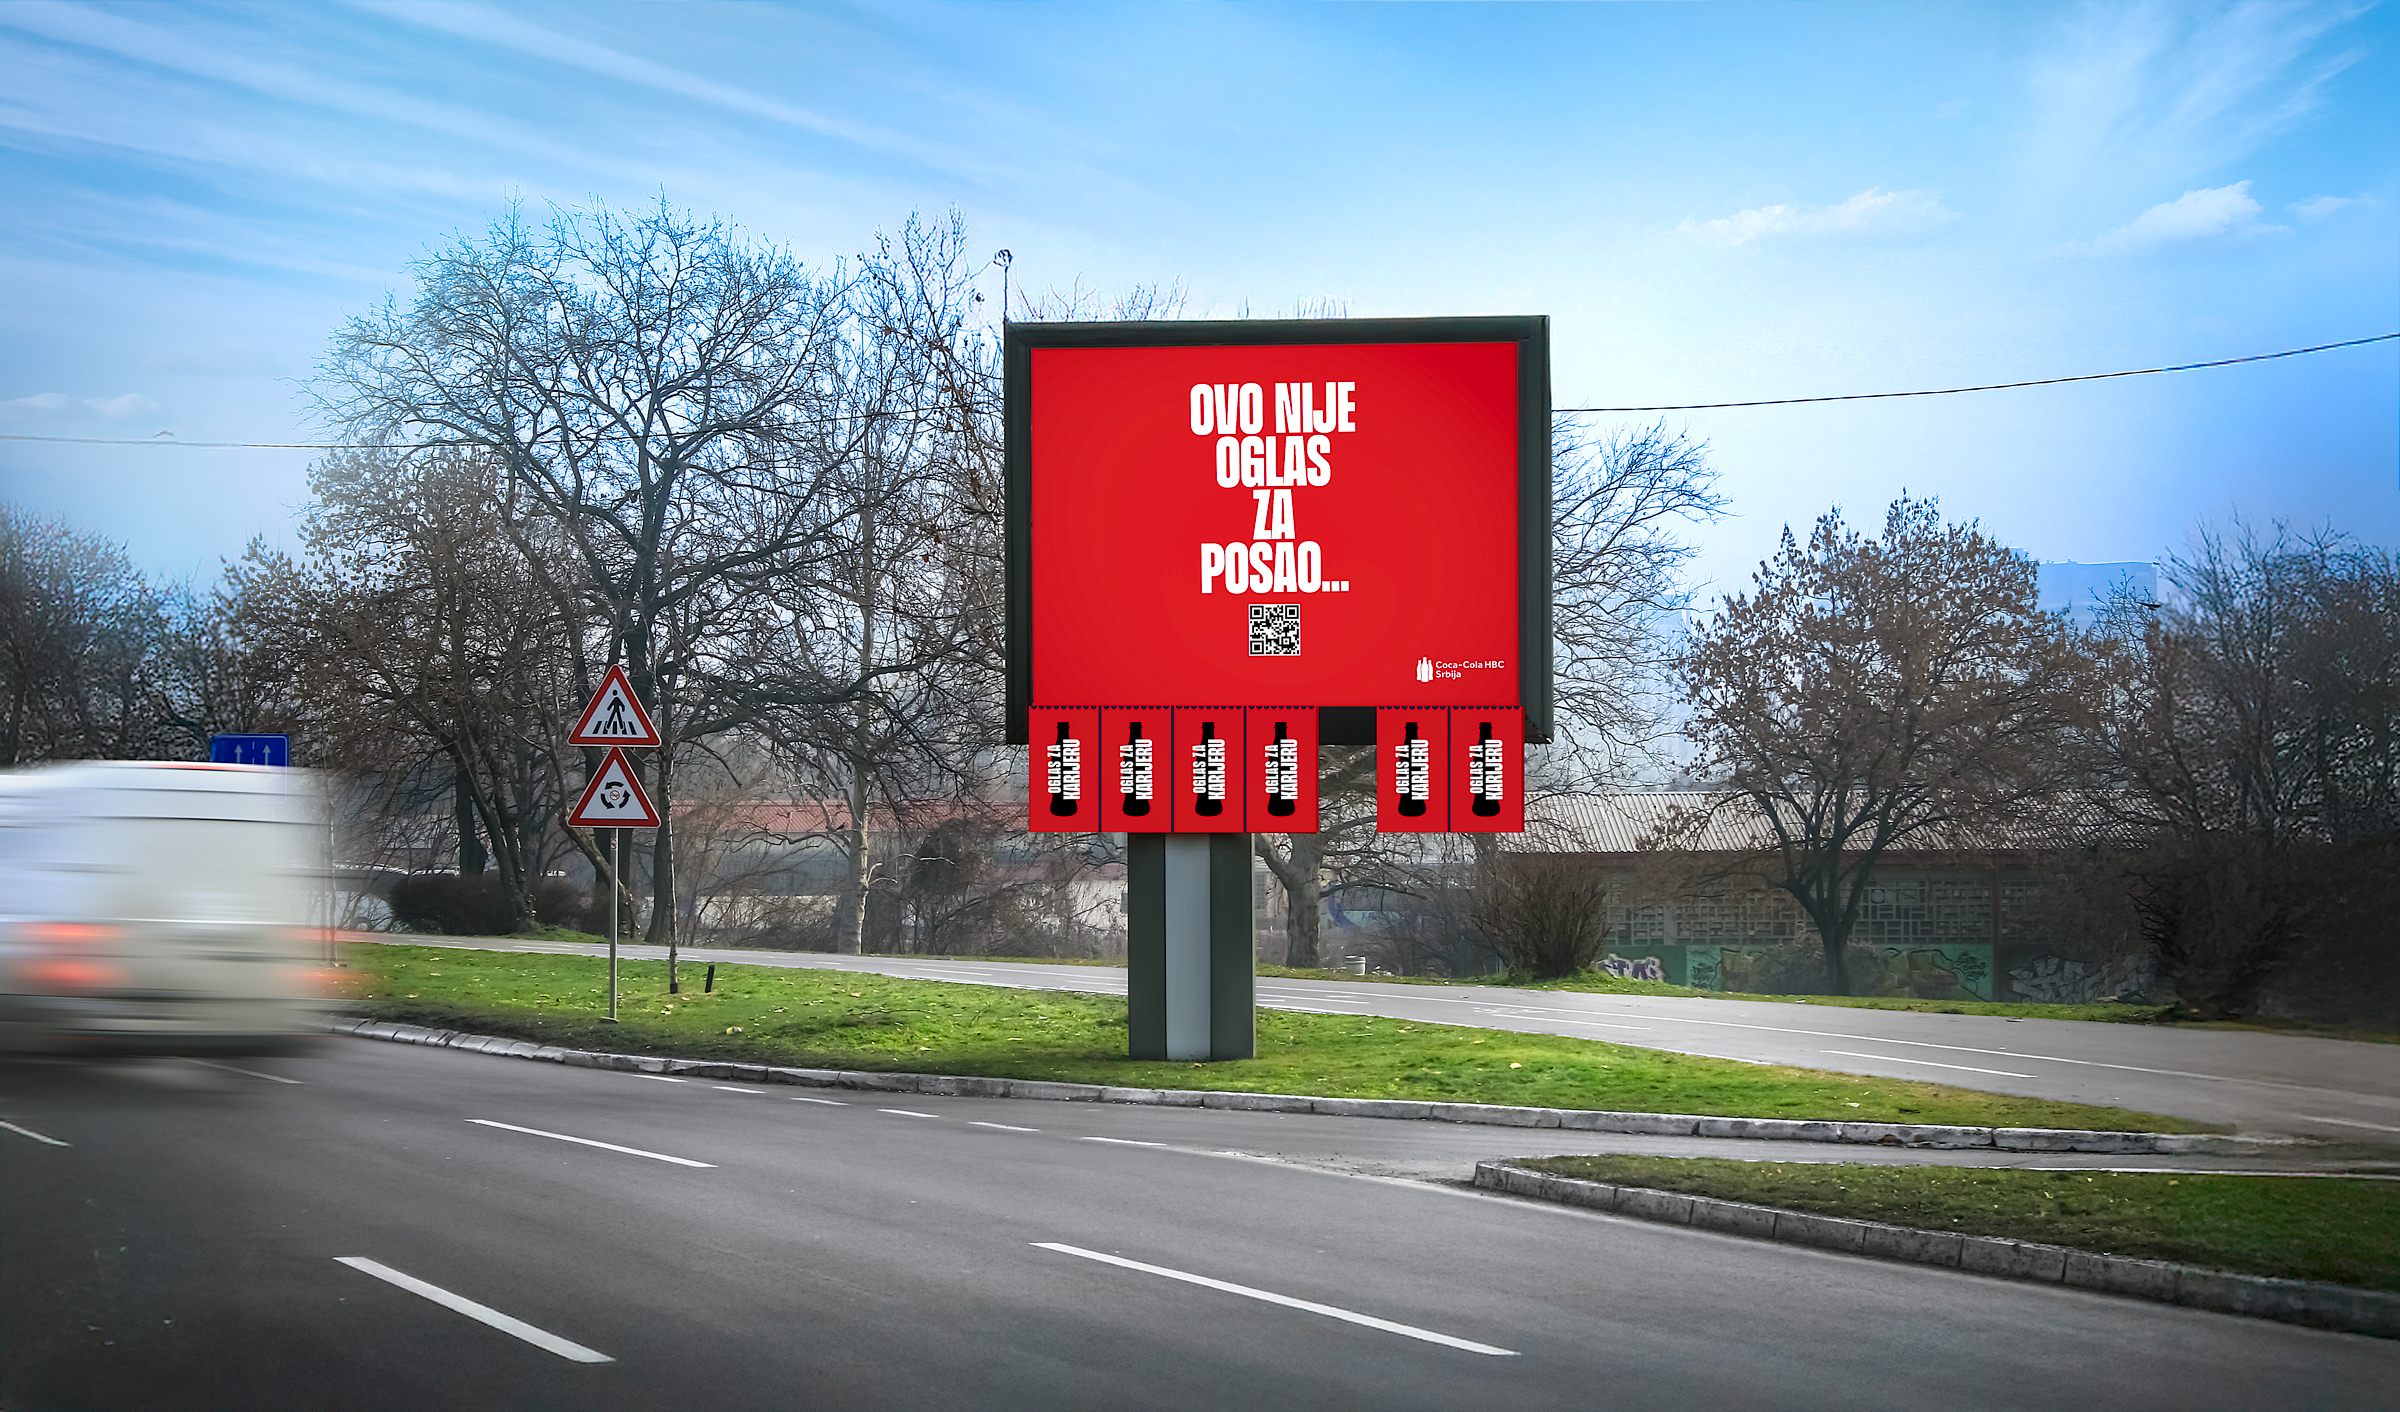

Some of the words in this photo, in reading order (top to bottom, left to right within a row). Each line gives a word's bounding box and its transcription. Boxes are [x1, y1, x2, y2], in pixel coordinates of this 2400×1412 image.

[1190, 382, 1264, 436] OVO
[1274, 381, 1356, 433] NIJE
[1215, 434, 1332, 488] OGLAS
[1252, 488, 1296, 540] ZA
[1200, 540, 1350, 594] POSAO...
[1435, 660, 1483, 669] Coca-Cola
[1484, 660, 1505, 669] HBC
[1435, 670, 1462, 680] Srbija
[1047, 744, 1062, 758] ZA
[1120, 744, 1134, 758] ZA
[1192, 744, 1207, 758] ZA
[1265, 744, 1280, 758] ZA
[1395, 744, 1410, 758] ZA
[1469, 744, 1484, 758] ZA
[1047, 760, 1062, 794] OGLAS
[1063, 739, 1081, 800] KARIJERU
[1120, 760, 1134, 794] OGLAS
[1135, 739, 1154, 800] KARIJERU
[1192, 760, 1207, 794] OGLAS
[1208, 739, 1226, 800] KARIJERU
[1265, 760, 1280, 794] OGLAS
[1280, 739, 1299, 800] KARIJERU
[1395, 760, 1410, 794] OGLAS
[1411, 739, 1430, 800] KARIJERU
[1469, 760, 1484, 794] OGLAS
[1485, 739, 1504, 800] KARIJERU
